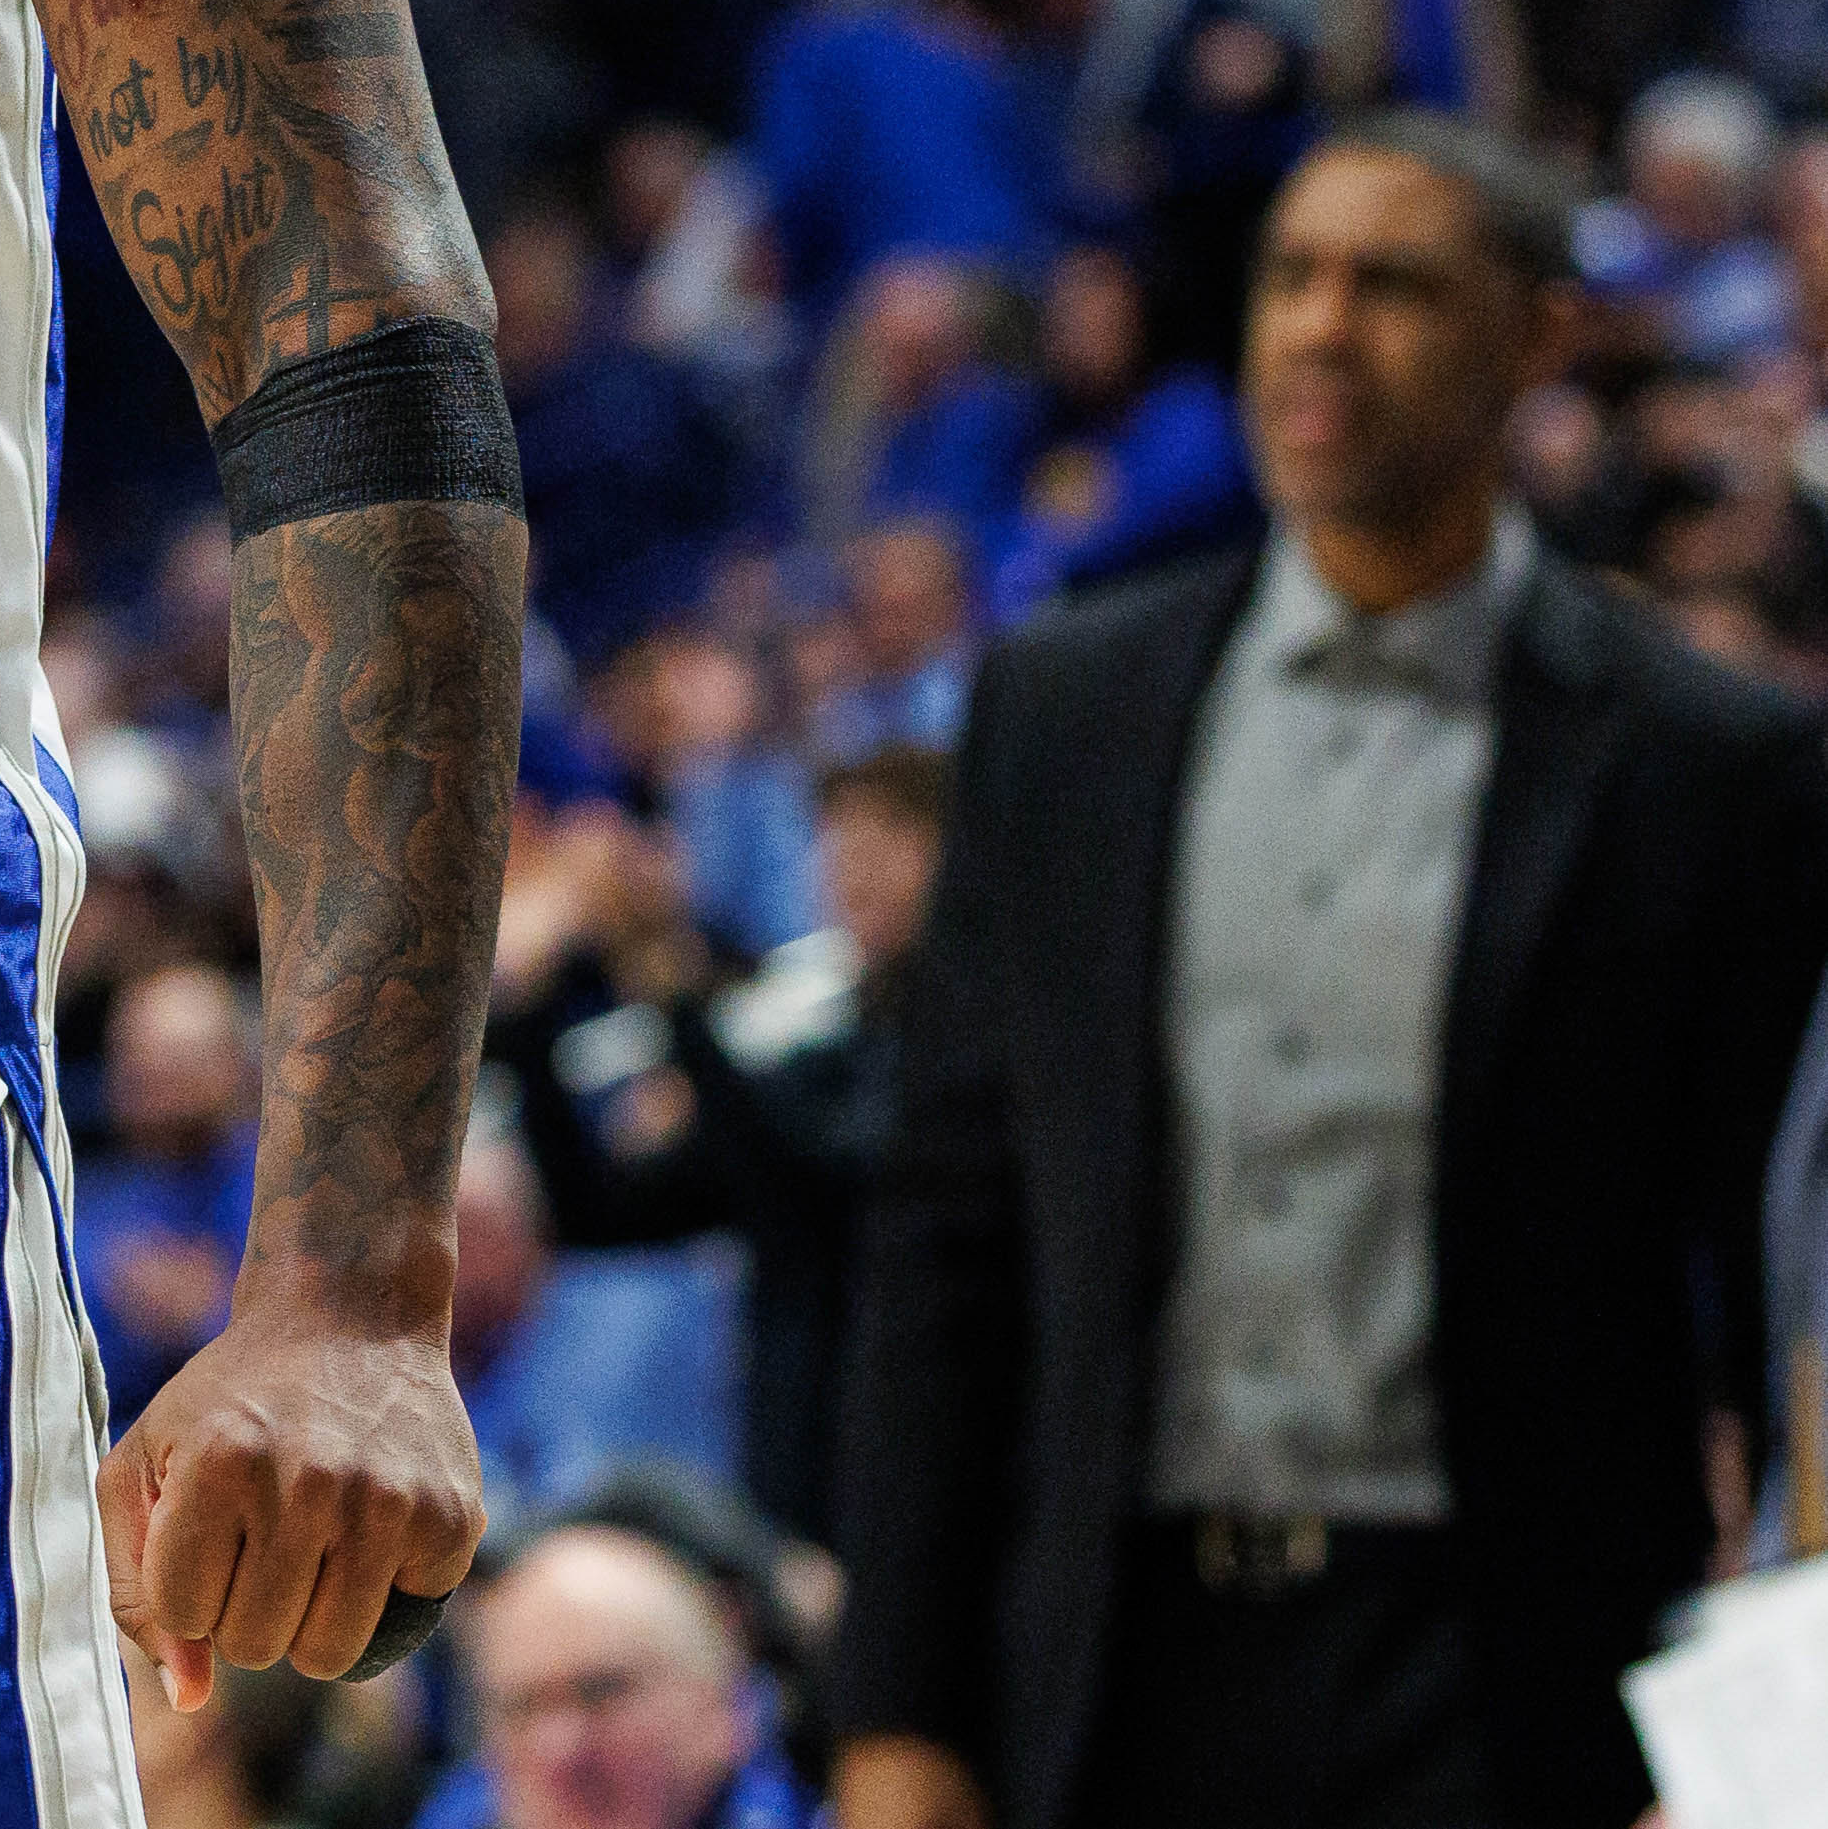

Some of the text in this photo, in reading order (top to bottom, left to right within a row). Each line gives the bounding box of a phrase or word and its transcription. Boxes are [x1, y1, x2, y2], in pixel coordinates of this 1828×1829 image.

[88, 35, 245, 164] not by
[130, 155, 275, 317] Sight
